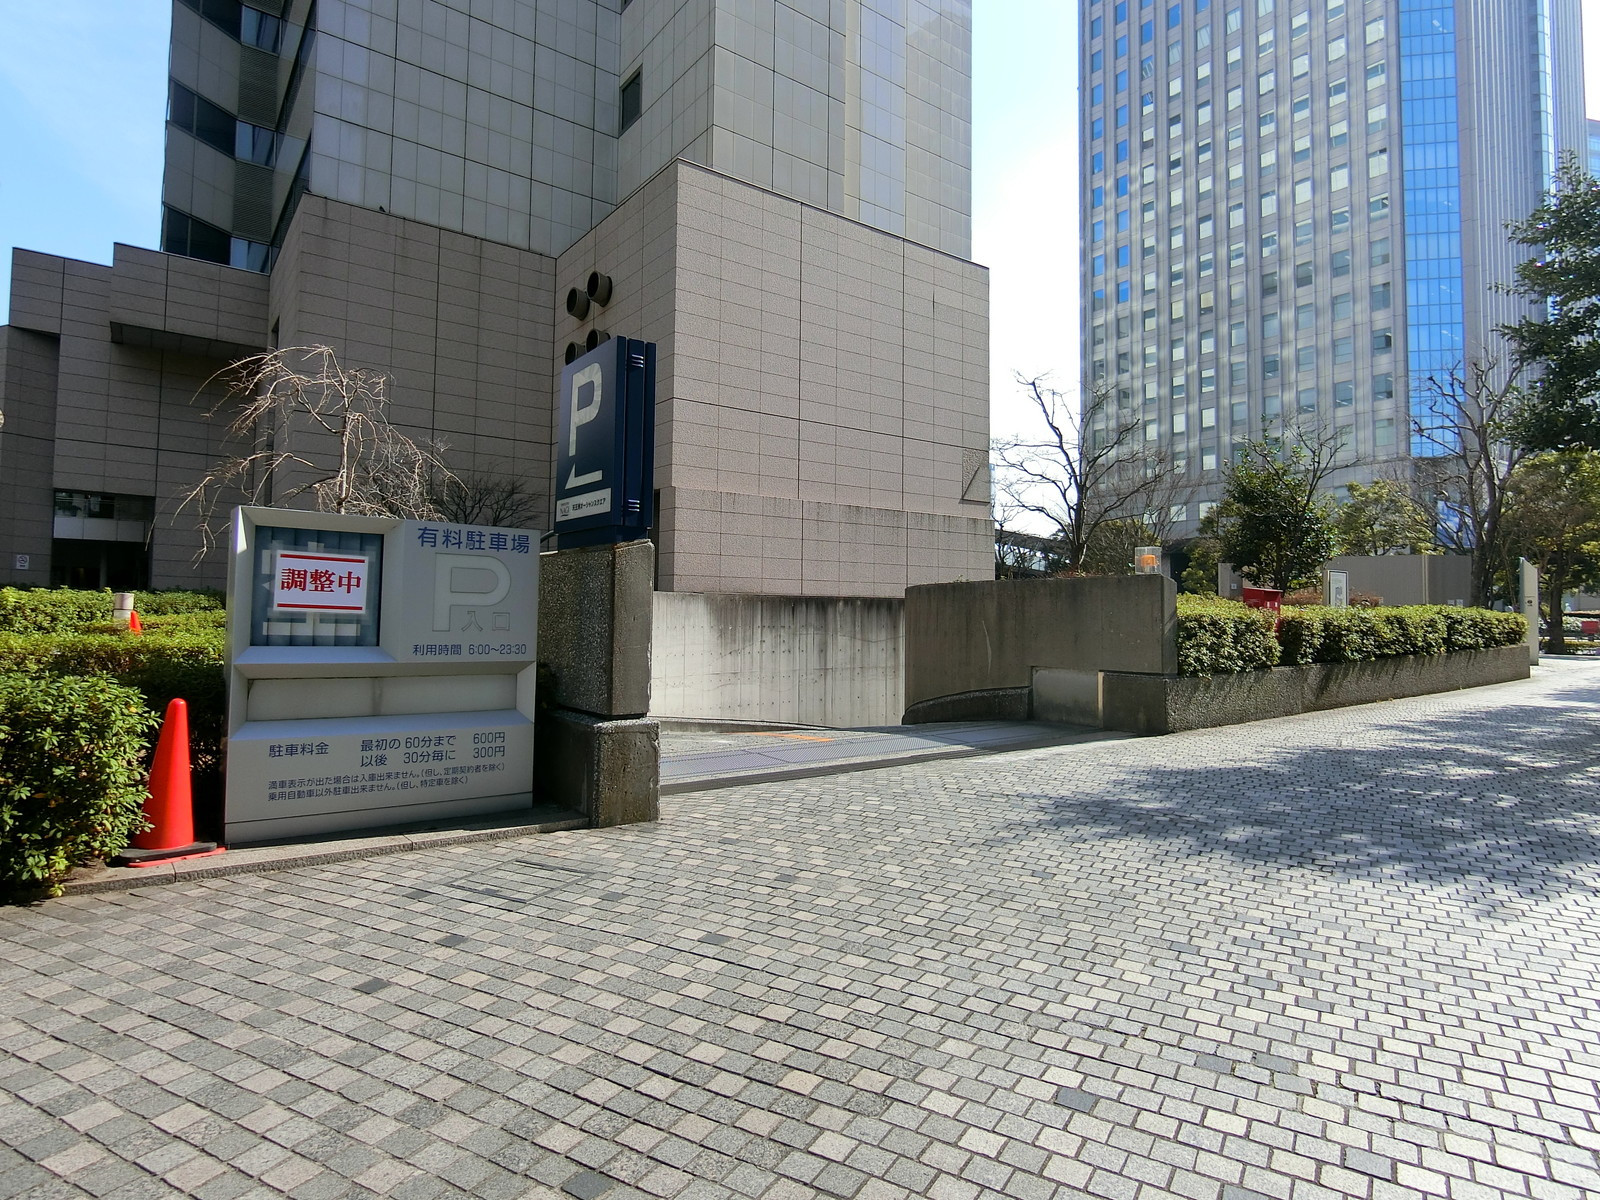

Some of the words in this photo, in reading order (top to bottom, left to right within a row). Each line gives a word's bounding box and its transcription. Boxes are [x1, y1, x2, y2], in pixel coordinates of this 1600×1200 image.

[569, 363, 602, 457] P
[418, 527, 530, 554] 有料駐車場
[281, 568, 361, 595] 調整中
[432, 552, 512, 632] P
[461, 610, 511, 632] 入口
[412, 644, 462, 656] 利用時間
[268, 742, 330, 758] 駐車料金
[472, 731, 506, 744] 600円
[360, 754, 388, 767] 以後
[403, 749, 456, 764] 30分毎に
[472, 745, 506, 758] 300円
